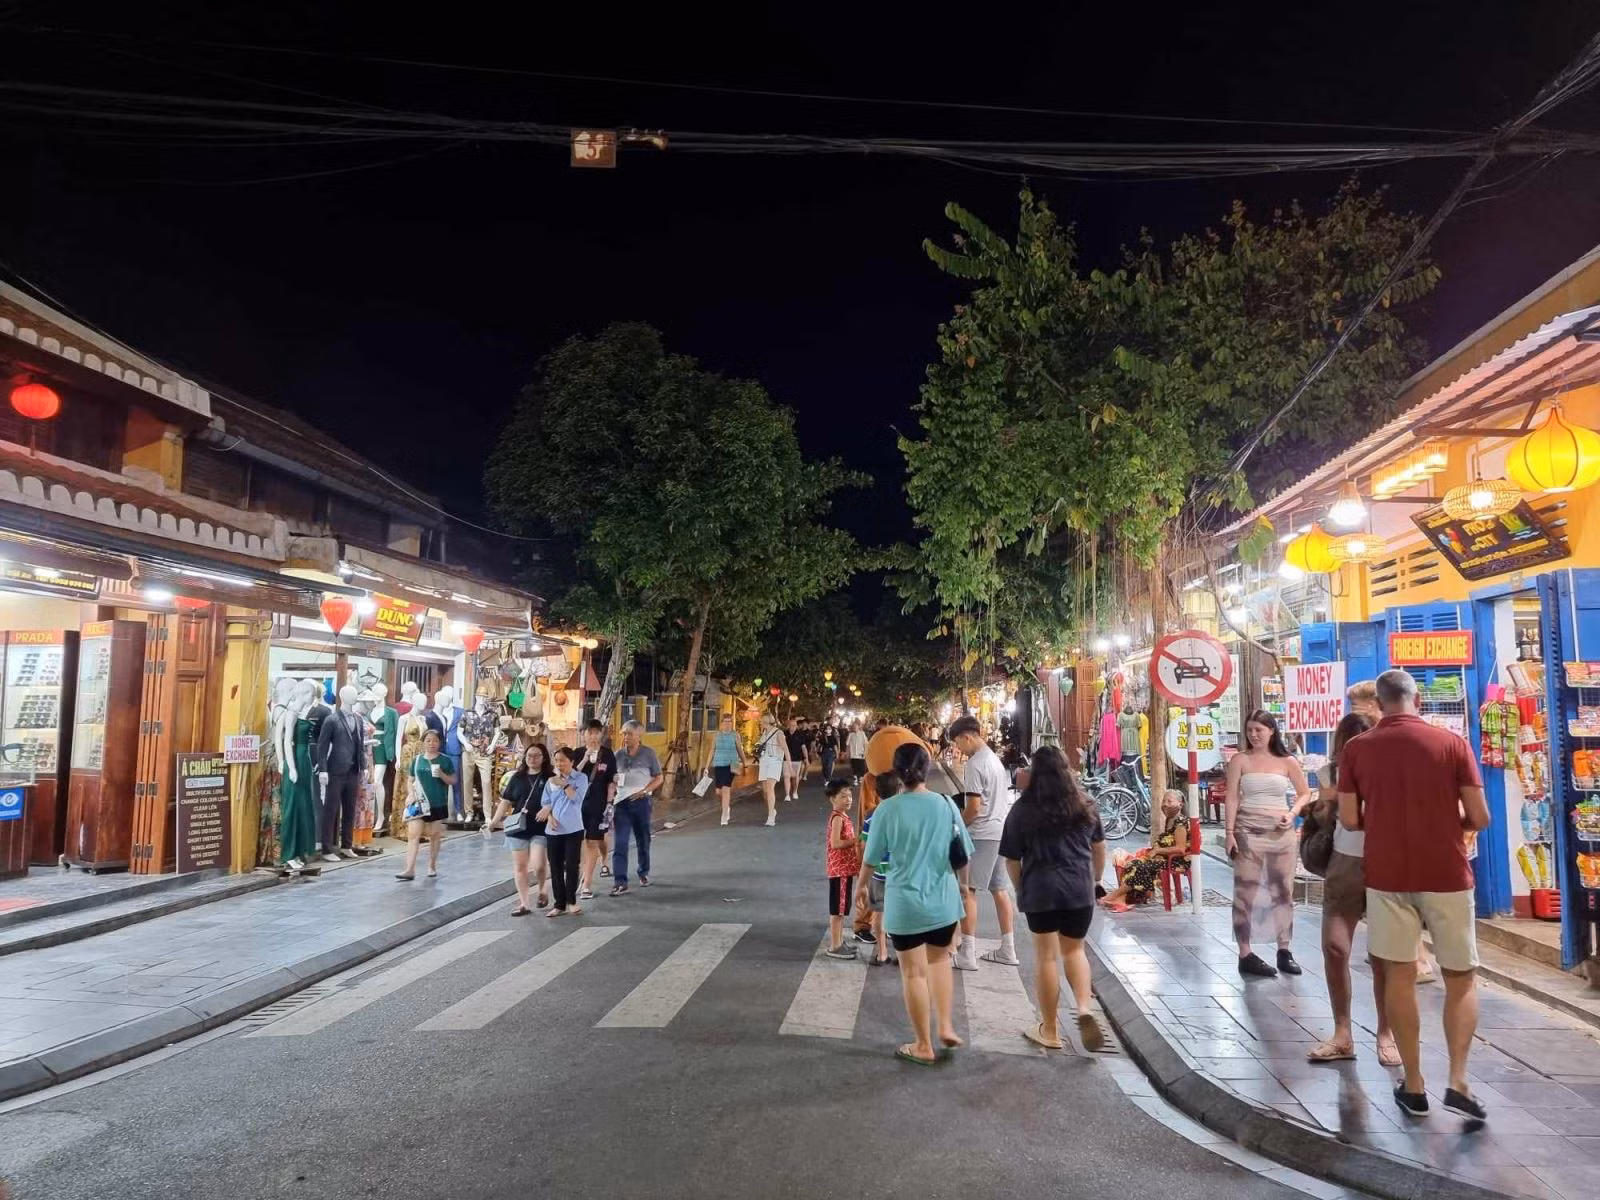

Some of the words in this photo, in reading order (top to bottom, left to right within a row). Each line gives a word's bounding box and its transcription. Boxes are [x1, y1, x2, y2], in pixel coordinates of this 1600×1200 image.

[15, 632, 53, 642] PRADA
[1393, 637, 1425, 660] FOREIGN
[1426, 635, 1468, 659] EXCHANGE
[1296, 665, 1333, 695] MONEY
[1289, 699, 1342, 731] EXCHANGE
[1178, 721, 1213, 735] Mni
[231, 737, 254, 748] MONEY
[1177, 736, 1214, 750] Mrt
[225, 750, 258, 761] EXCHANGE
